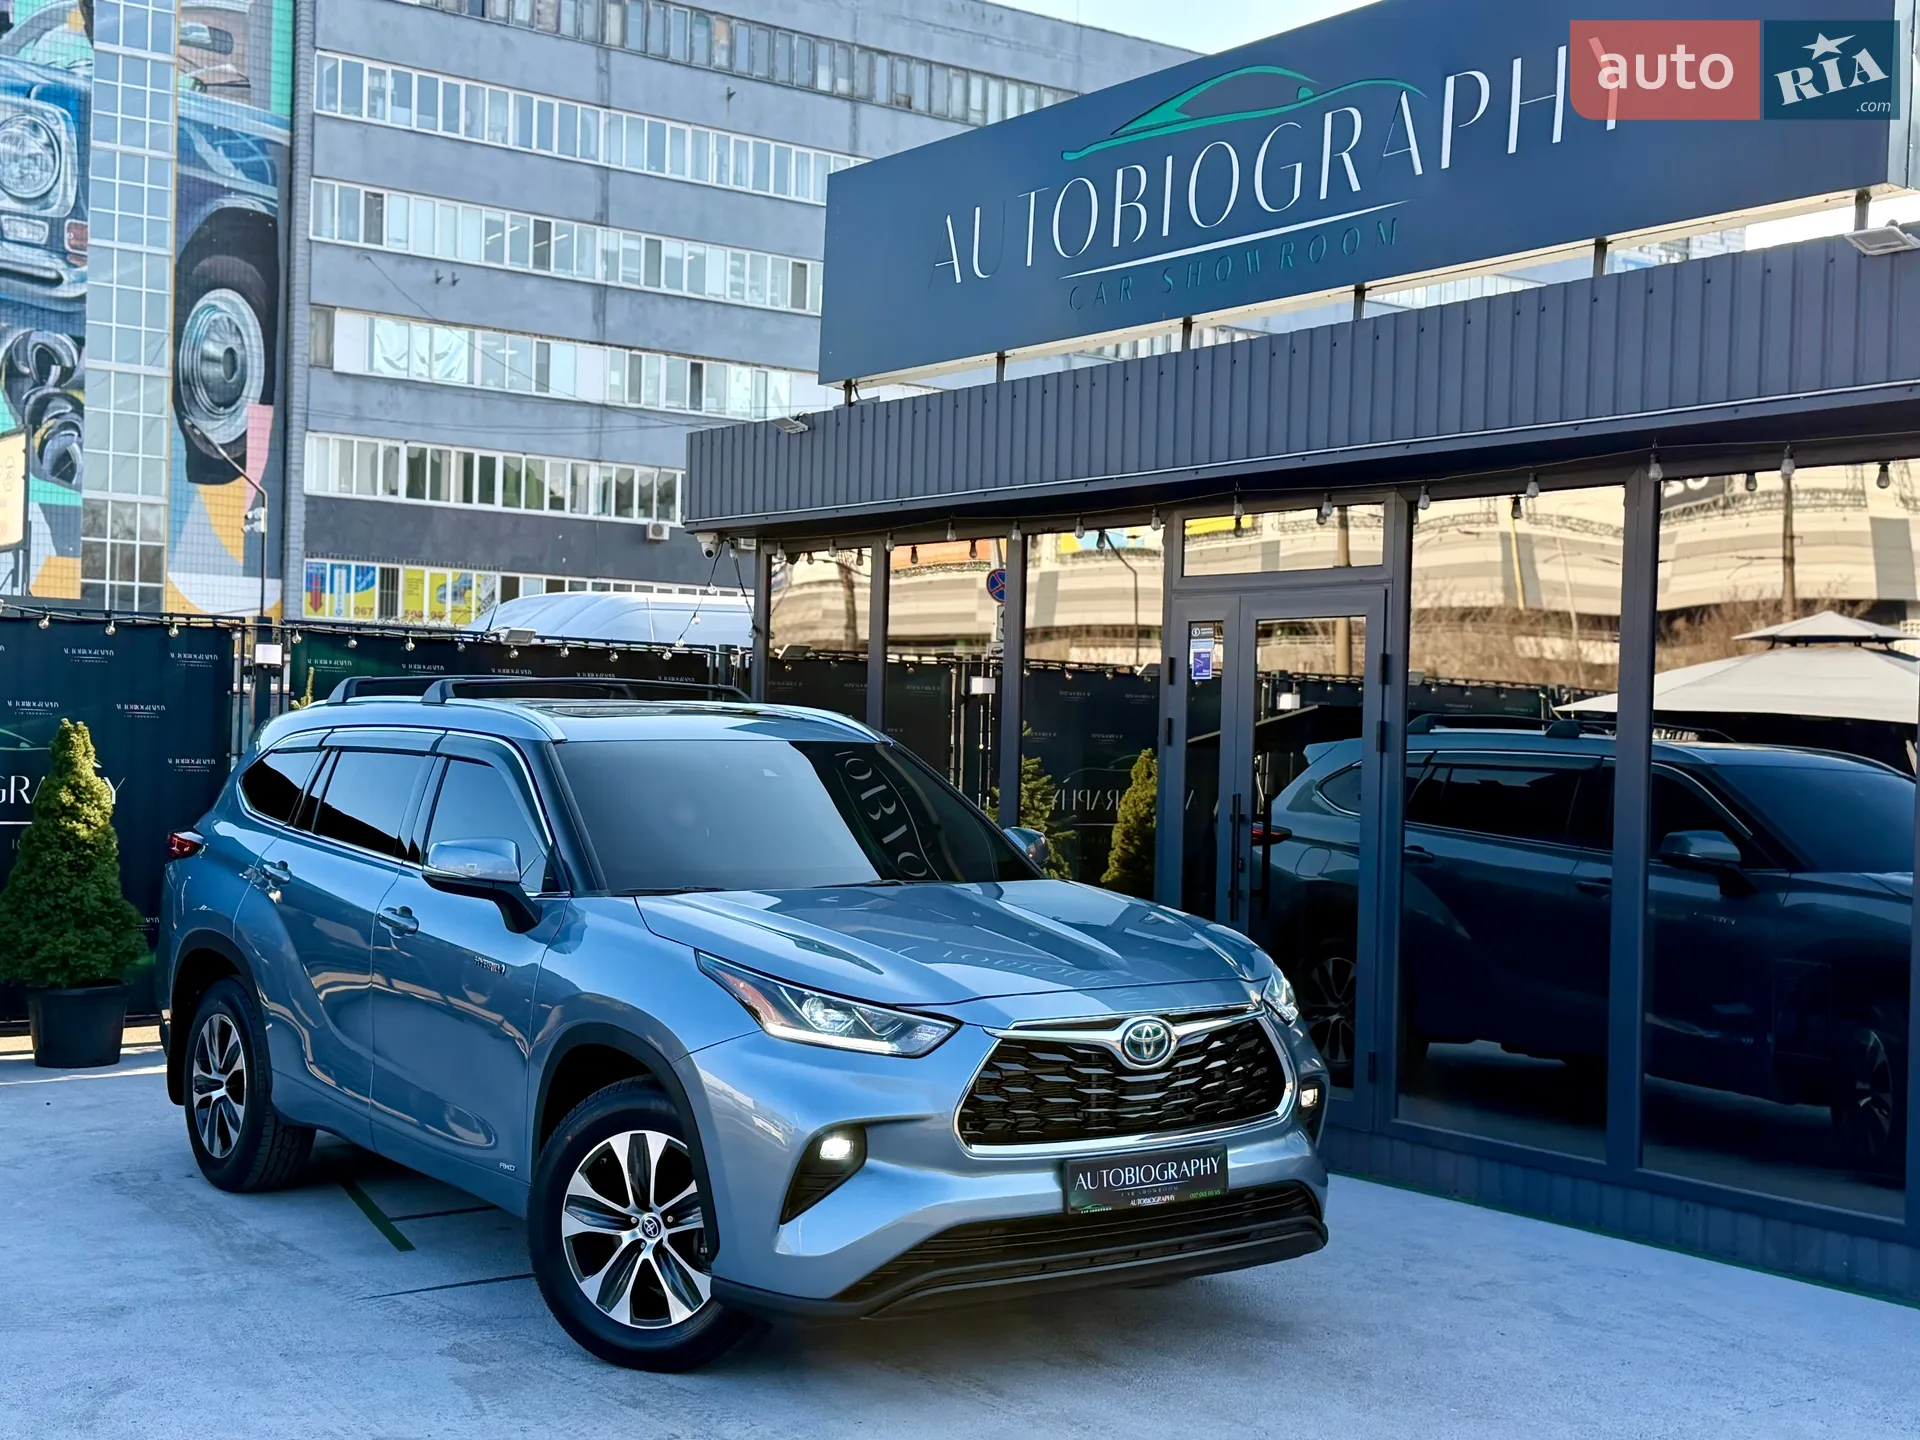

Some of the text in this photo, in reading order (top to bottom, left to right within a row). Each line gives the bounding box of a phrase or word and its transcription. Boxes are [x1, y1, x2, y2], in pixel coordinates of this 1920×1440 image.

[1069, 217, 1398, 311] CAR SHOWROOM
[1074, 1155, 1221, 1191] AUTOBIOGRAPHY
